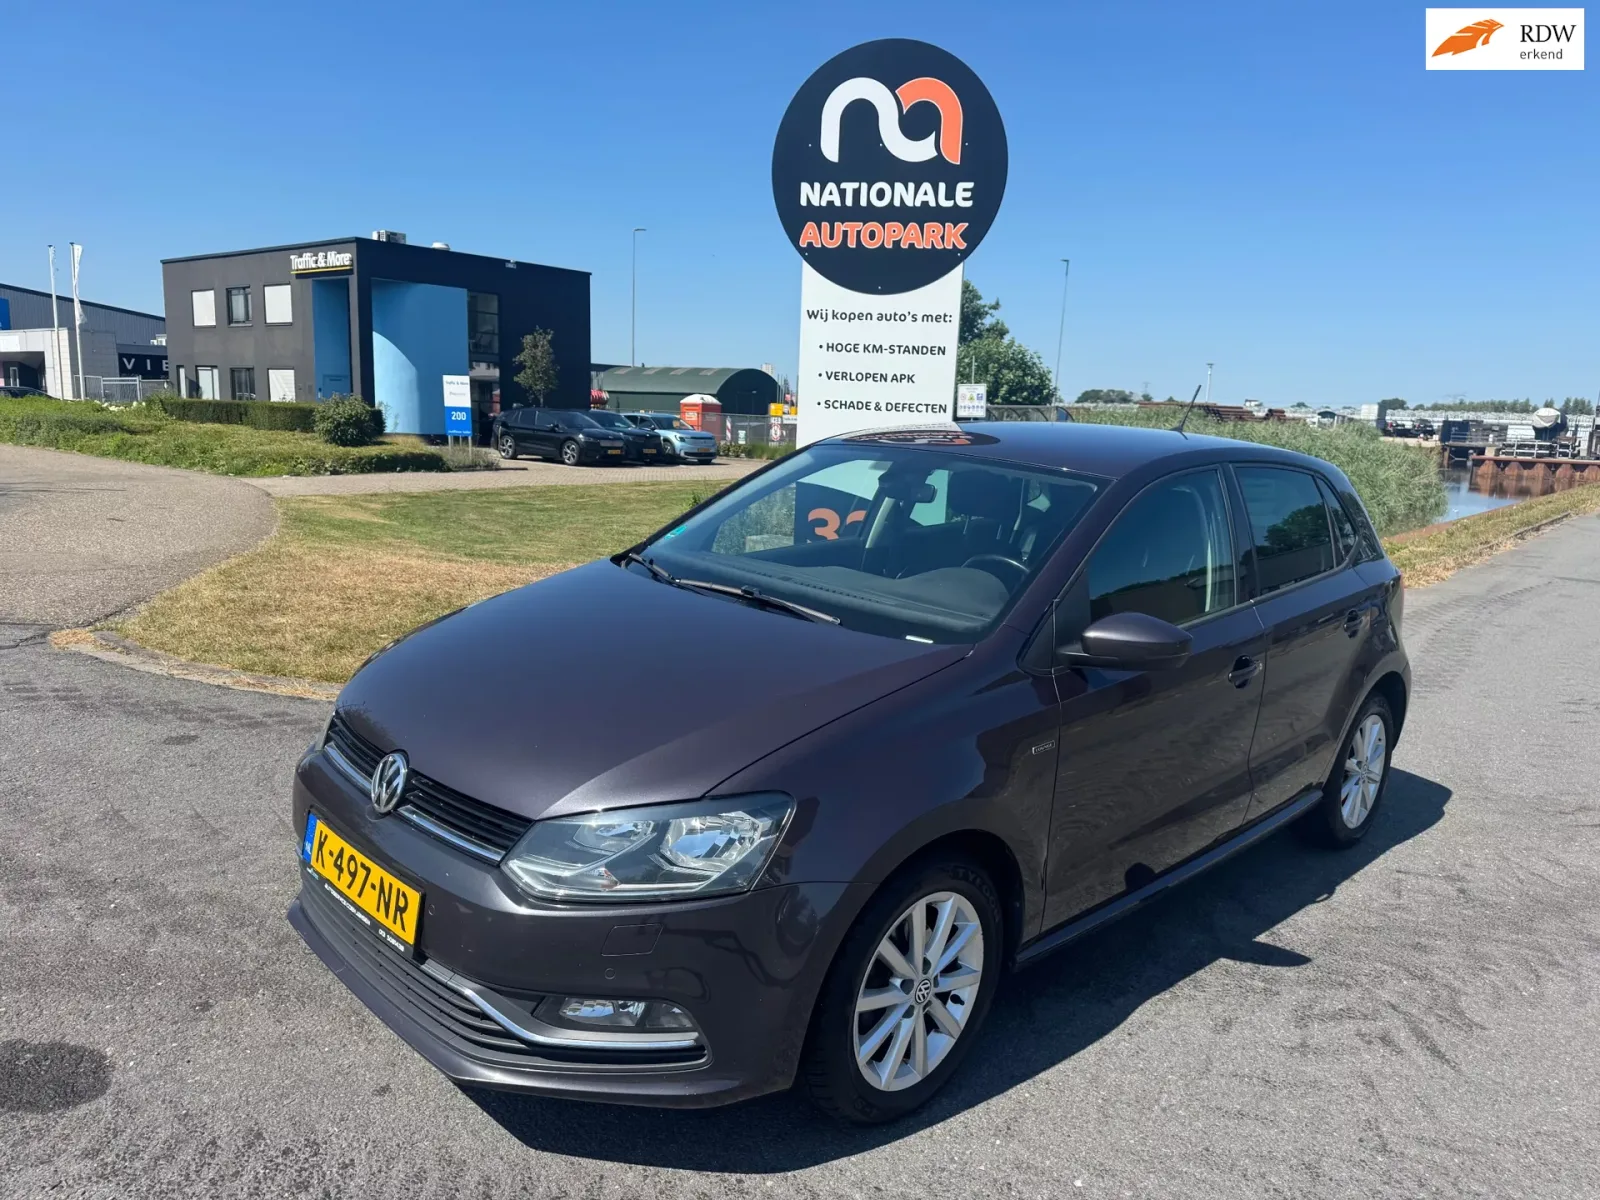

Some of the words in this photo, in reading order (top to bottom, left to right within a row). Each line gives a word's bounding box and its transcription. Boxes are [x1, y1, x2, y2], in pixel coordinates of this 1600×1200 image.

[800, 182, 974, 207] NATIONALE
[799, 221, 969, 249] AUTOPARK
[290, 252, 318, 270] Traffic
[317, 251, 327, 268] &
[327, 250, 352, 267] More
[806, 309, 829, 323] Wij
[831, 309, 873, 323] kopen
[876, 311, 918, 323] auto's
[921, 312, 953, 323] met:
[826, 342, 860, 353] HOGE
[863, 343, 946, 356] KM-STANDEN
[825, 370, 888, 383] VERLOPEN
[890, 373, 916, 384] APK
[824, 399, 872, 411] SCHADE
[873, 401, 883, 412] &
[885, 402, 947, 414] DEFECTEN
[451, 411, 467, 421] 200
[315, 829, 409, 933] K-497-NR
